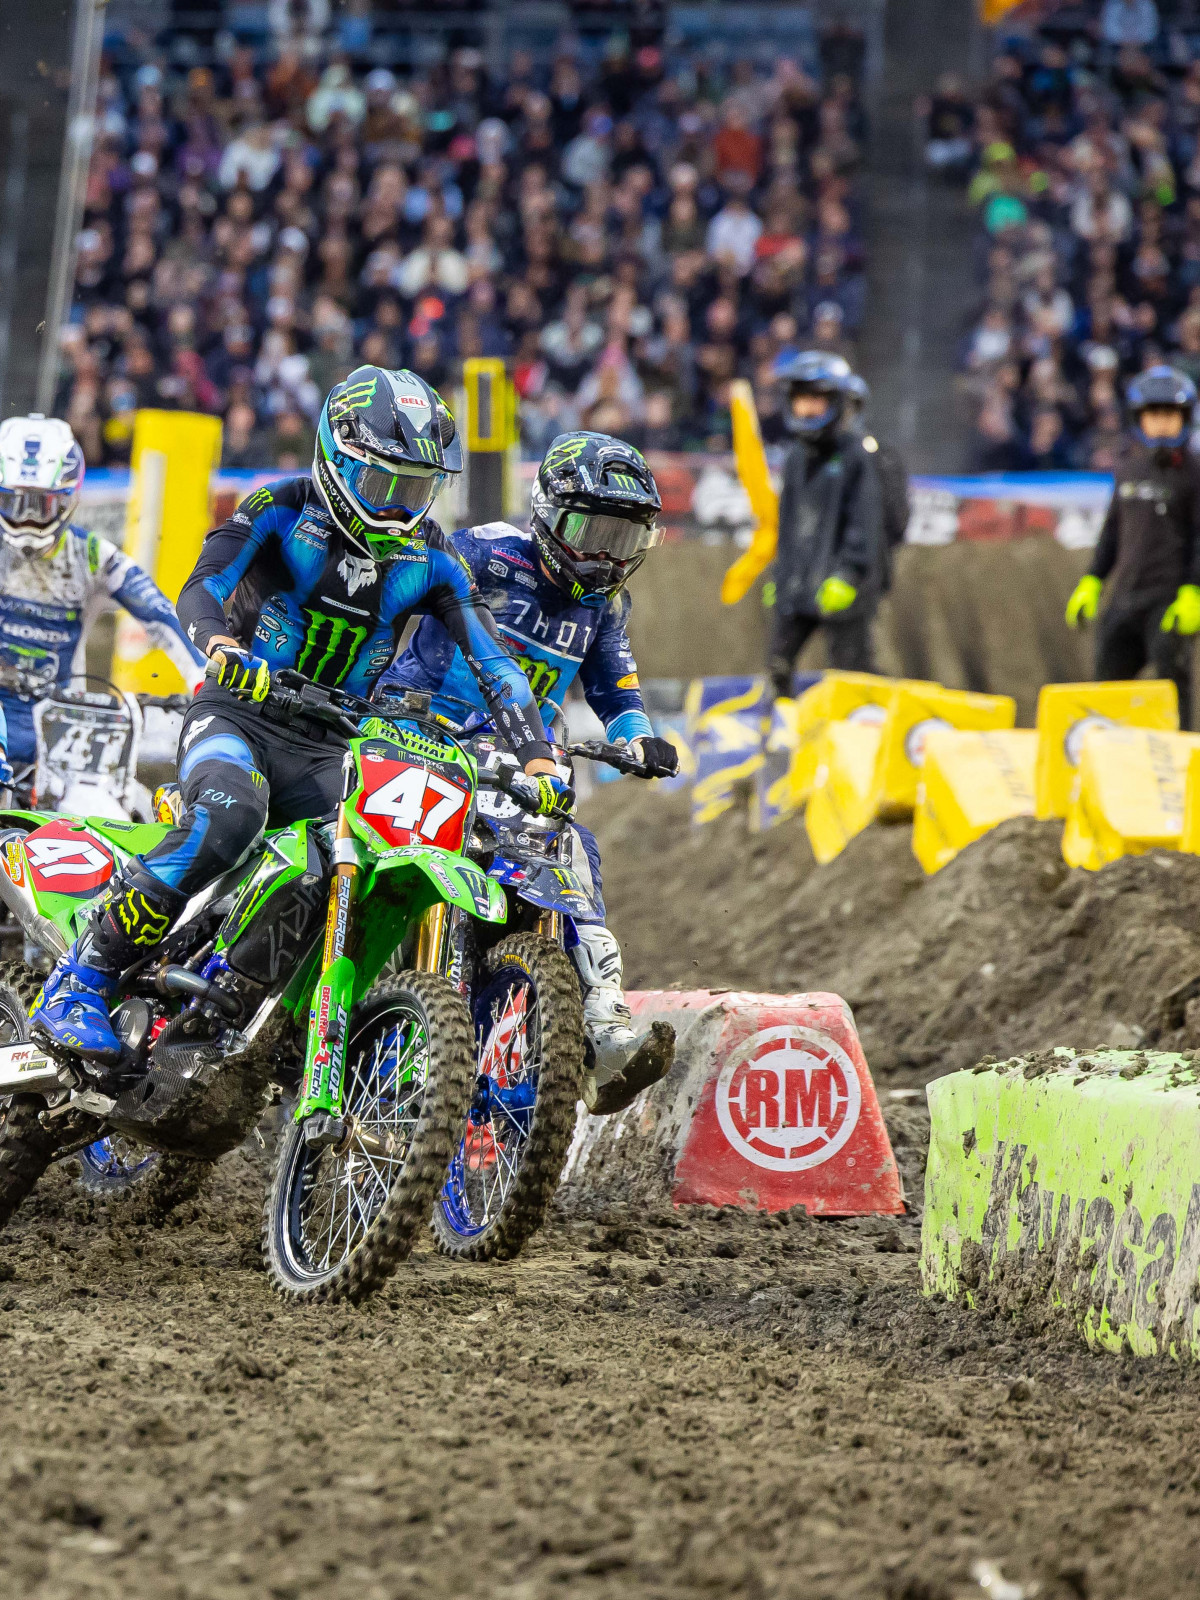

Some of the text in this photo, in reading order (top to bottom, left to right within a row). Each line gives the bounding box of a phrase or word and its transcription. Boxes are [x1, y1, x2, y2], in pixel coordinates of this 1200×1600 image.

[400, 397, 427, 407] BELL
[319, 463, 351, 517] MONSTER
[390, 553, 428, 564] awasak
[3, 621, 71, 643] HONDA
[201, 787, 238, 809] FOX
[362, 766, 467, 842] 47
[23, 837, 110, 880] 47
[317, 985, 331, 1040] BRAKING
[62, 1031, 85, 1048] FOX
[327, 1003, 348, 1101] DUNLOP
[11, 1051, 30, 1062] RK
[744, 1068, 821, 1129] RM
